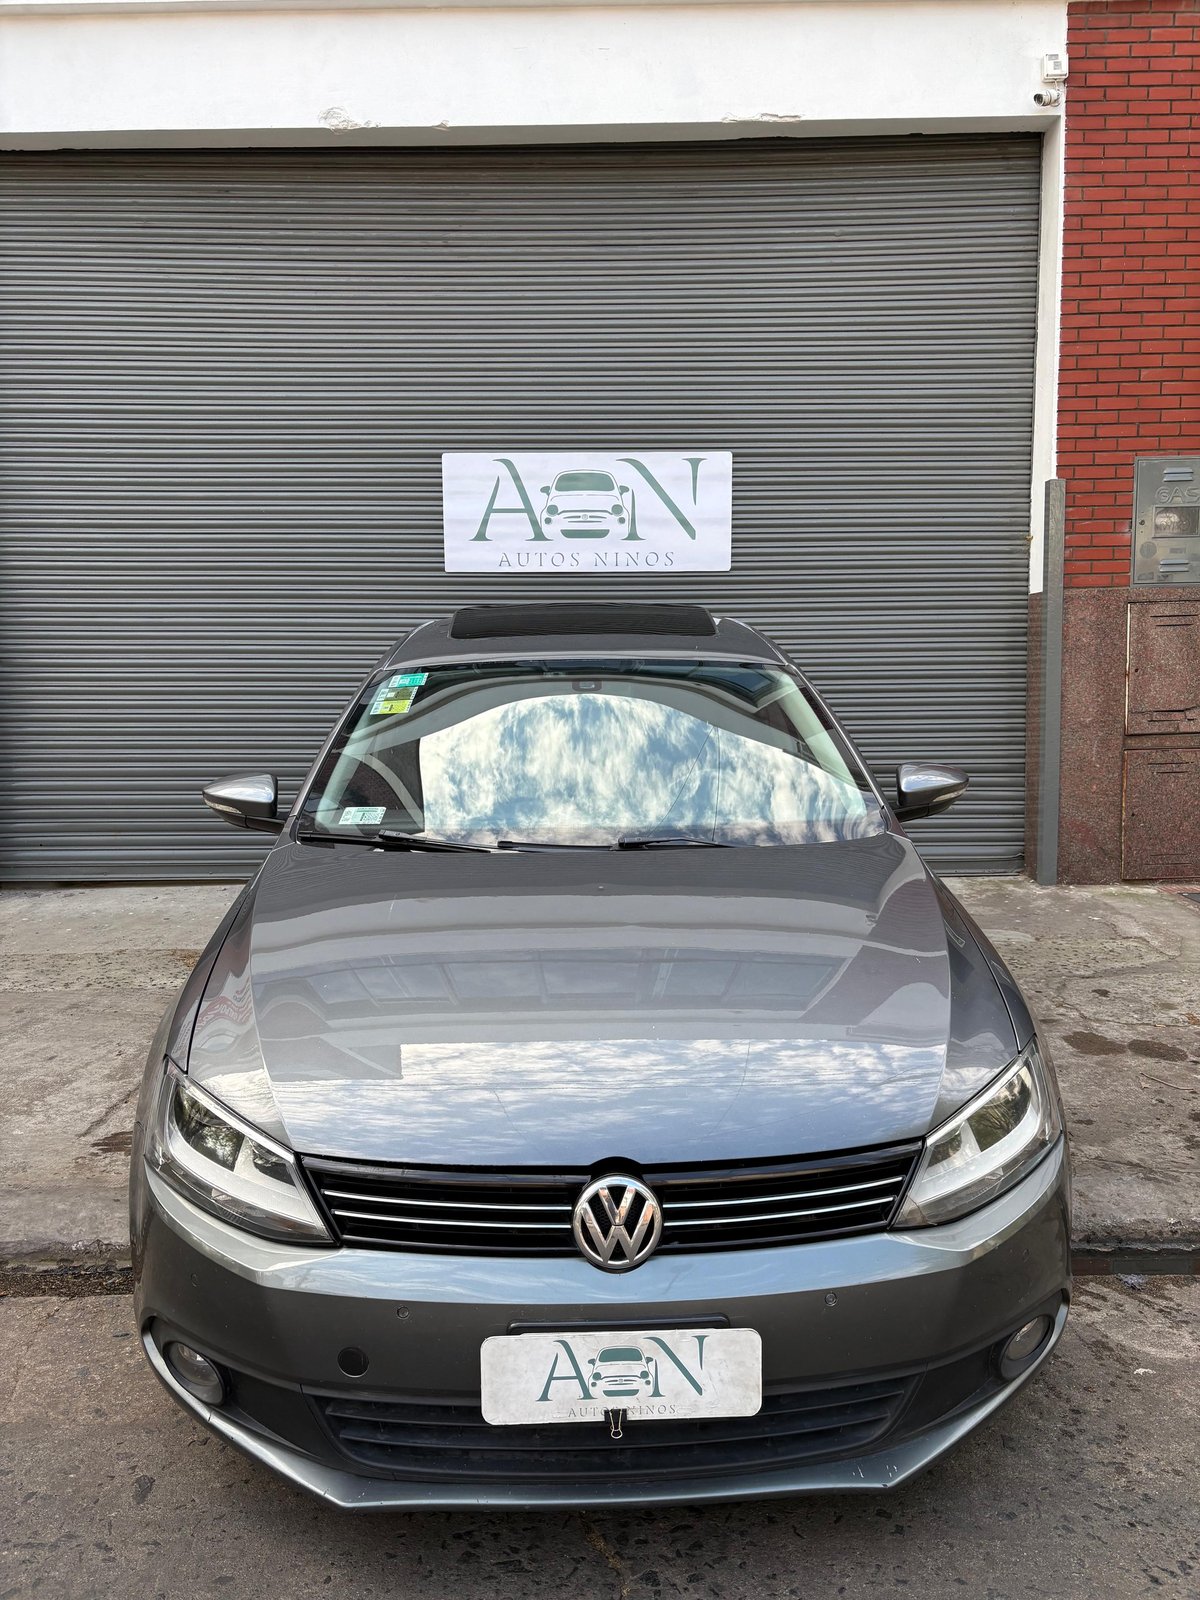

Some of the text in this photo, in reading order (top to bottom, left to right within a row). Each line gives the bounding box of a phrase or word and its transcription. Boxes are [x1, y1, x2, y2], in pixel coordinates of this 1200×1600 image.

[1155, 485, 1200, 504] GAS
[498, 551, 675, 567] AUTOS NINOS
[576, 1177, 659, 1267] VW
[568, 1404, 677, 1418] AUTO NINOS
